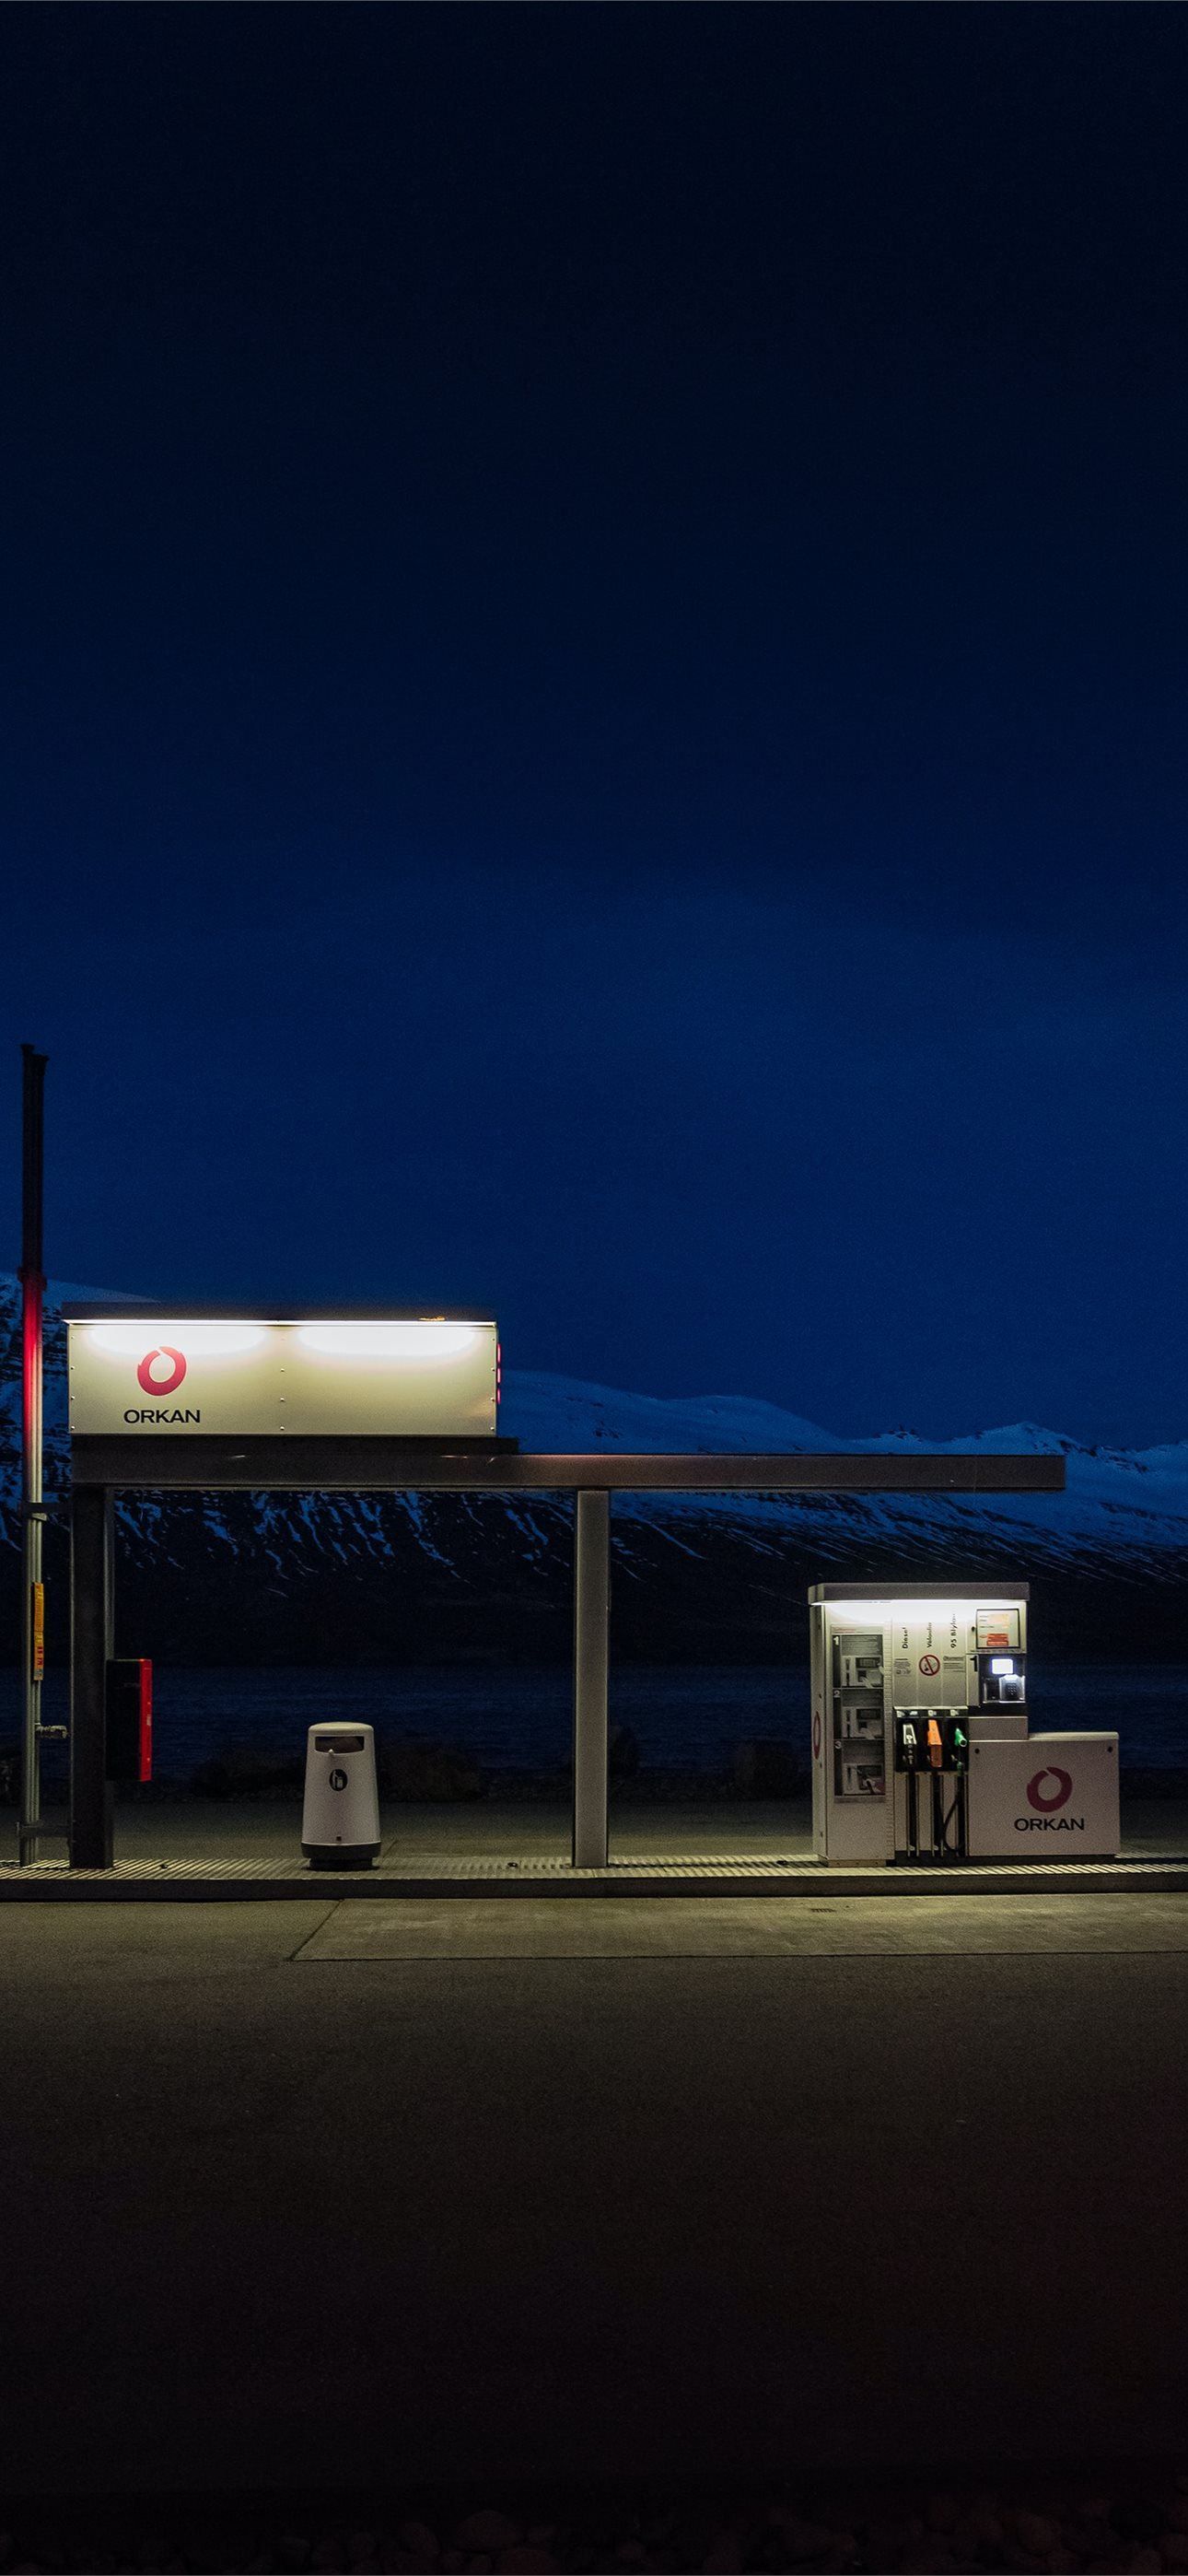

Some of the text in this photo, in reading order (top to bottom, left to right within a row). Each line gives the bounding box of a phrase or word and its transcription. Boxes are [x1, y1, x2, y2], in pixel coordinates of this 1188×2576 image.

[123, 1409, 201, 1423] ORKAN
[833, 1635, 840, 1645] 1
[949, 1638, 957, 1649] 95
[970, 1656, 978, 1672] 1
[833, 1690, 841, 1698] 2
[834, 1740, 842, 1749] 3
[1014, 1818, 1085, 1832] ORKAN
